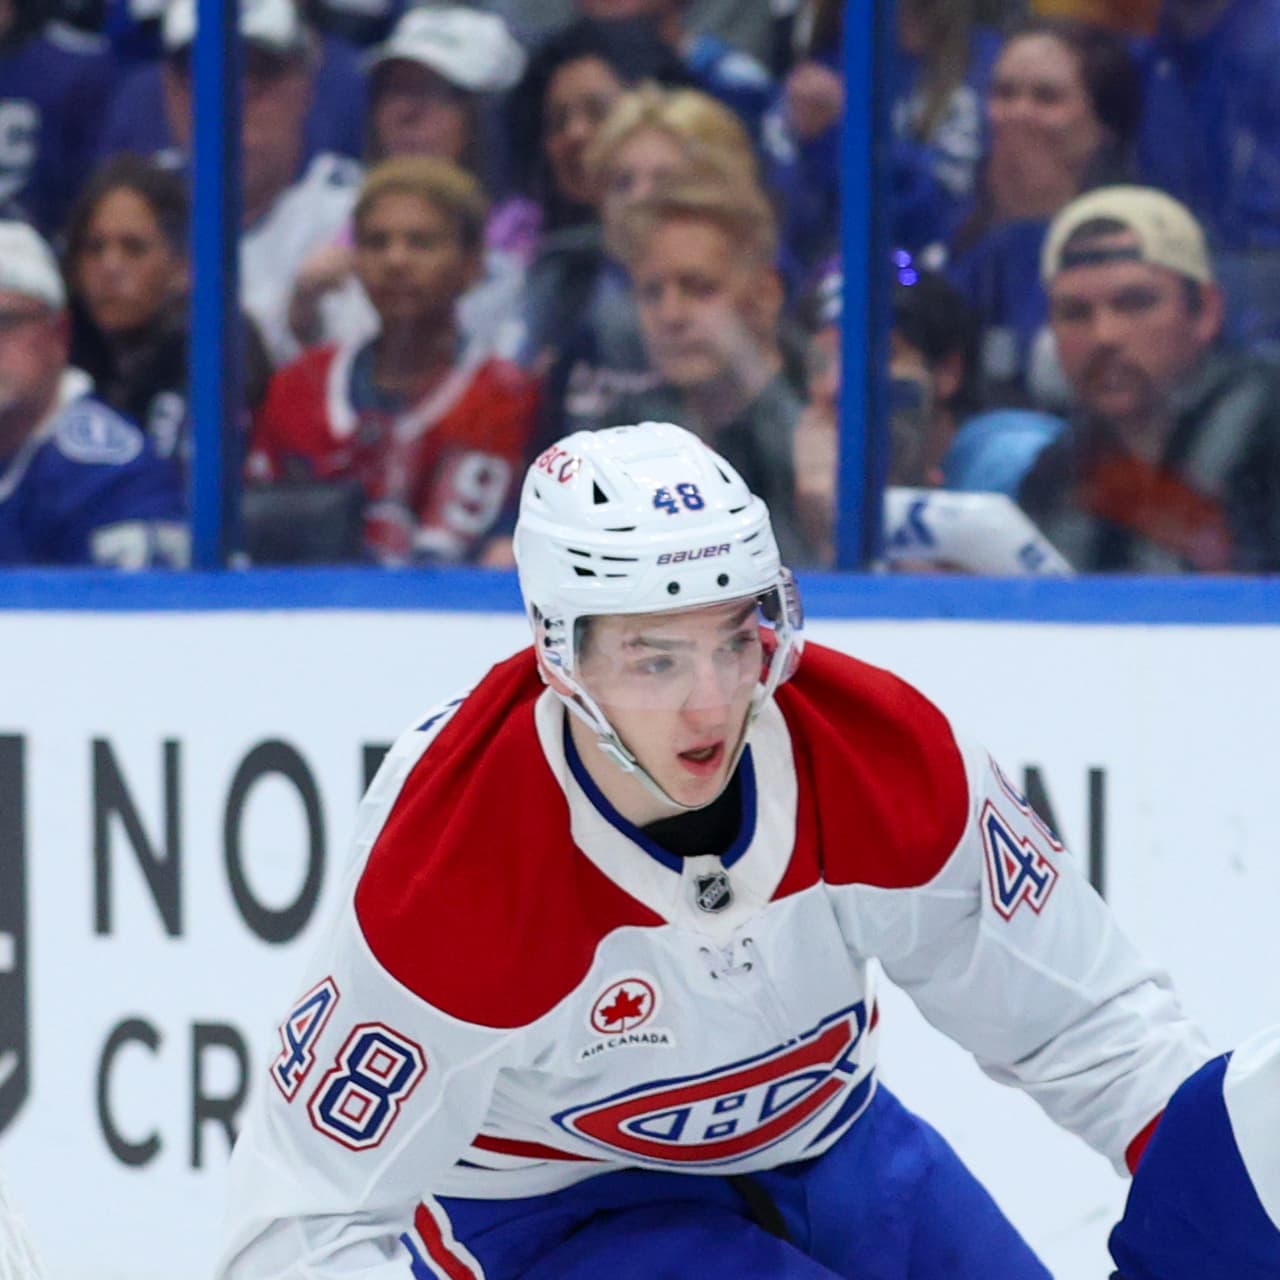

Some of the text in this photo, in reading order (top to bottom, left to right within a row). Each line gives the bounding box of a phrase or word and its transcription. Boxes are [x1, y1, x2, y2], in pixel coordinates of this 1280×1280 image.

[652, 482, 705, 515] 48
[656, 543, 731, 566] BAUER
[979, 768, 1064, 922] 4
[582, 1032, 669, 1059] AIR CANADA
[270, 975, 428, 1151] 48
